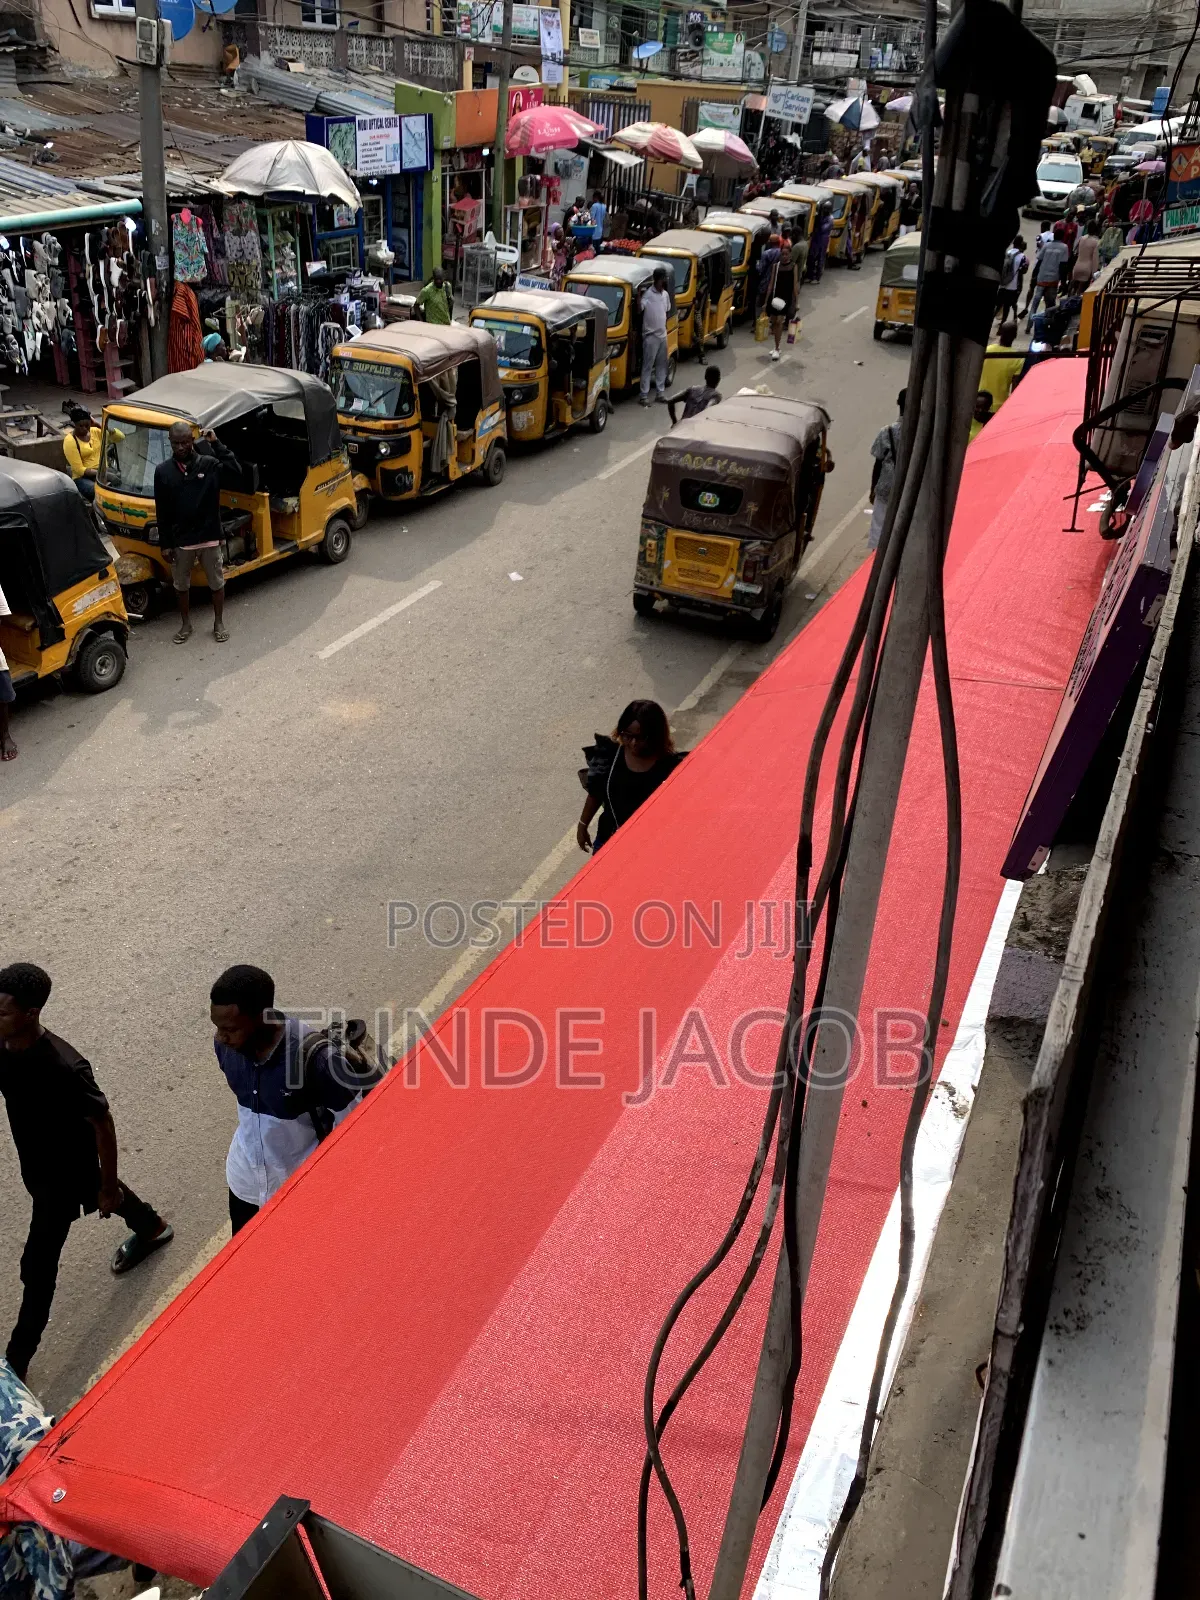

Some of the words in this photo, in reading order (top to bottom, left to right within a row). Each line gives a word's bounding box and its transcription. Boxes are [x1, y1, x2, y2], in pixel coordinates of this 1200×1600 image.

[689, 12, 702, 22] POS
[784, 100, 808, 113] Service
[368, 117, 384, 131] OPTICAL
[384, 116, 399, 129] CENTRE
